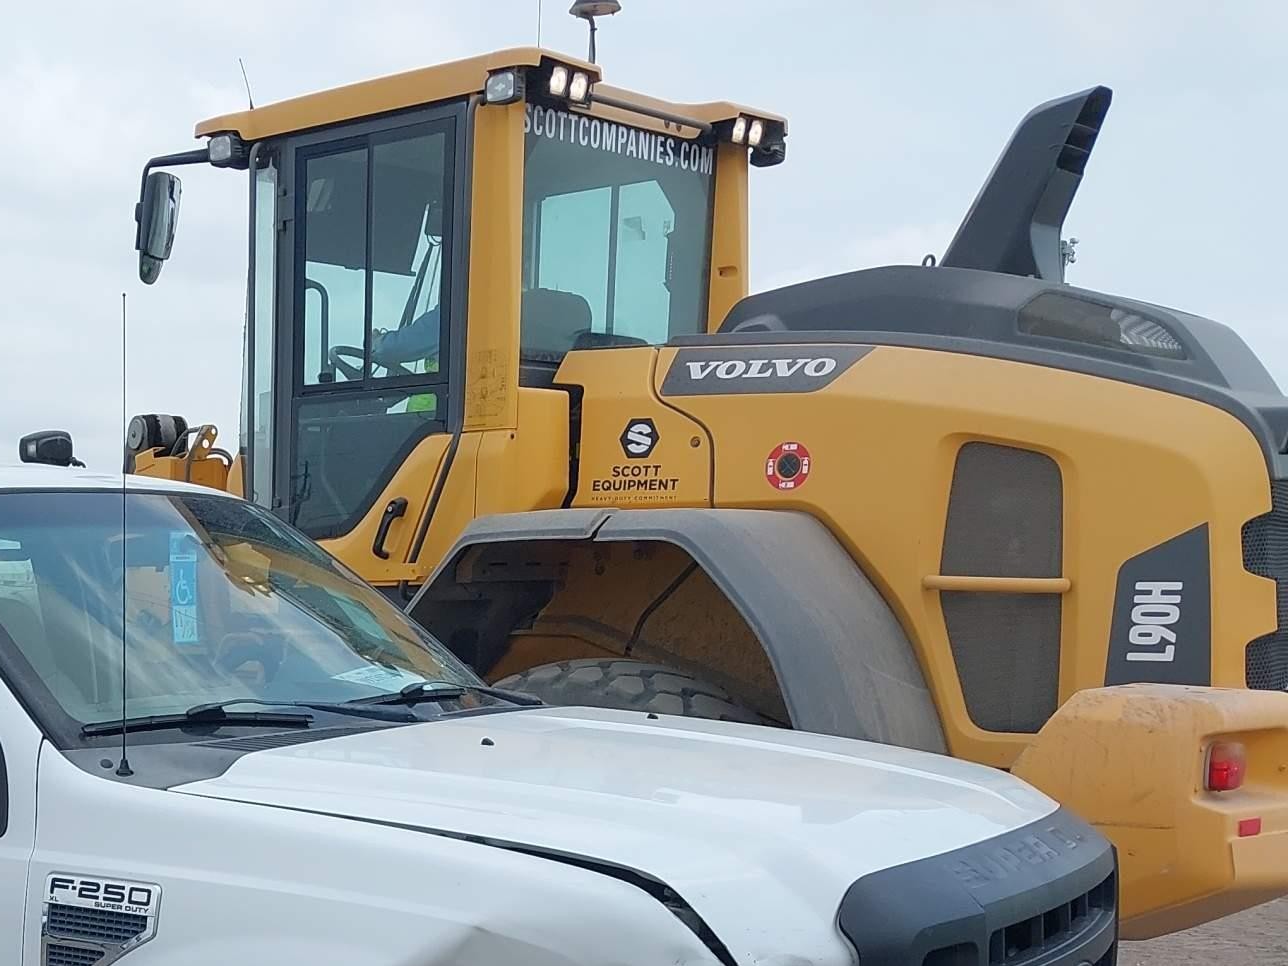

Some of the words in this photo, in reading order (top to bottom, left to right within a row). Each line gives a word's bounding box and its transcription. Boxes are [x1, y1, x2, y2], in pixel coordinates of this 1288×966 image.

[525, 103, 713, 175] SCOTTCOMPANIES.COM
[686, 357, 837, 380] VOLVO
[612, 464, 662, 478] SCOTT
[592, 478, 679, 492] EQUIPMENT
[1126, 581, 1183, 662] L90H
[50, 877, 152, 907] F-250
[94, 901, 123, 911] SUPER
[125, 905, 149, 914] DUTY
